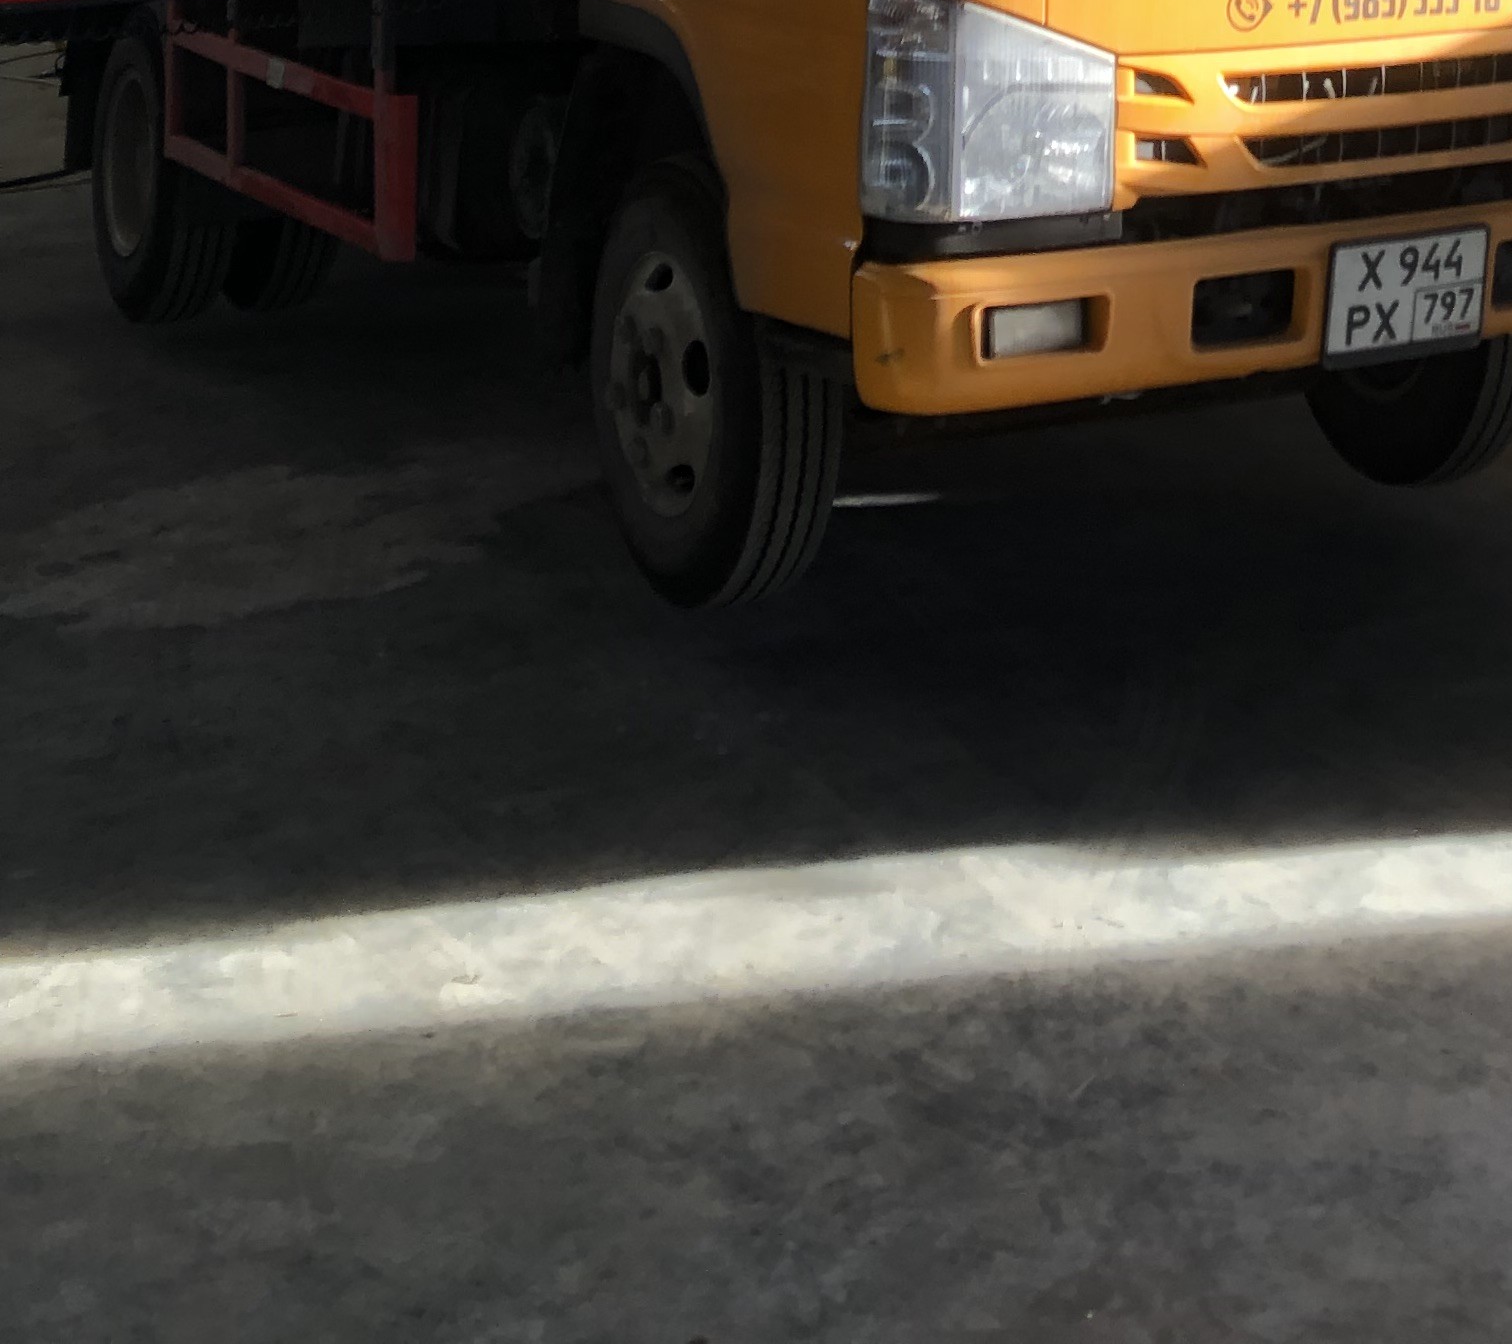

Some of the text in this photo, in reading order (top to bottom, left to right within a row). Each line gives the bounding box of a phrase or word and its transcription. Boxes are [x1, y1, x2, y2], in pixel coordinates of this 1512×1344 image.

[1399, 238, 1463, 287] 944
[1345, 287, 1475, 346] РХ 797
